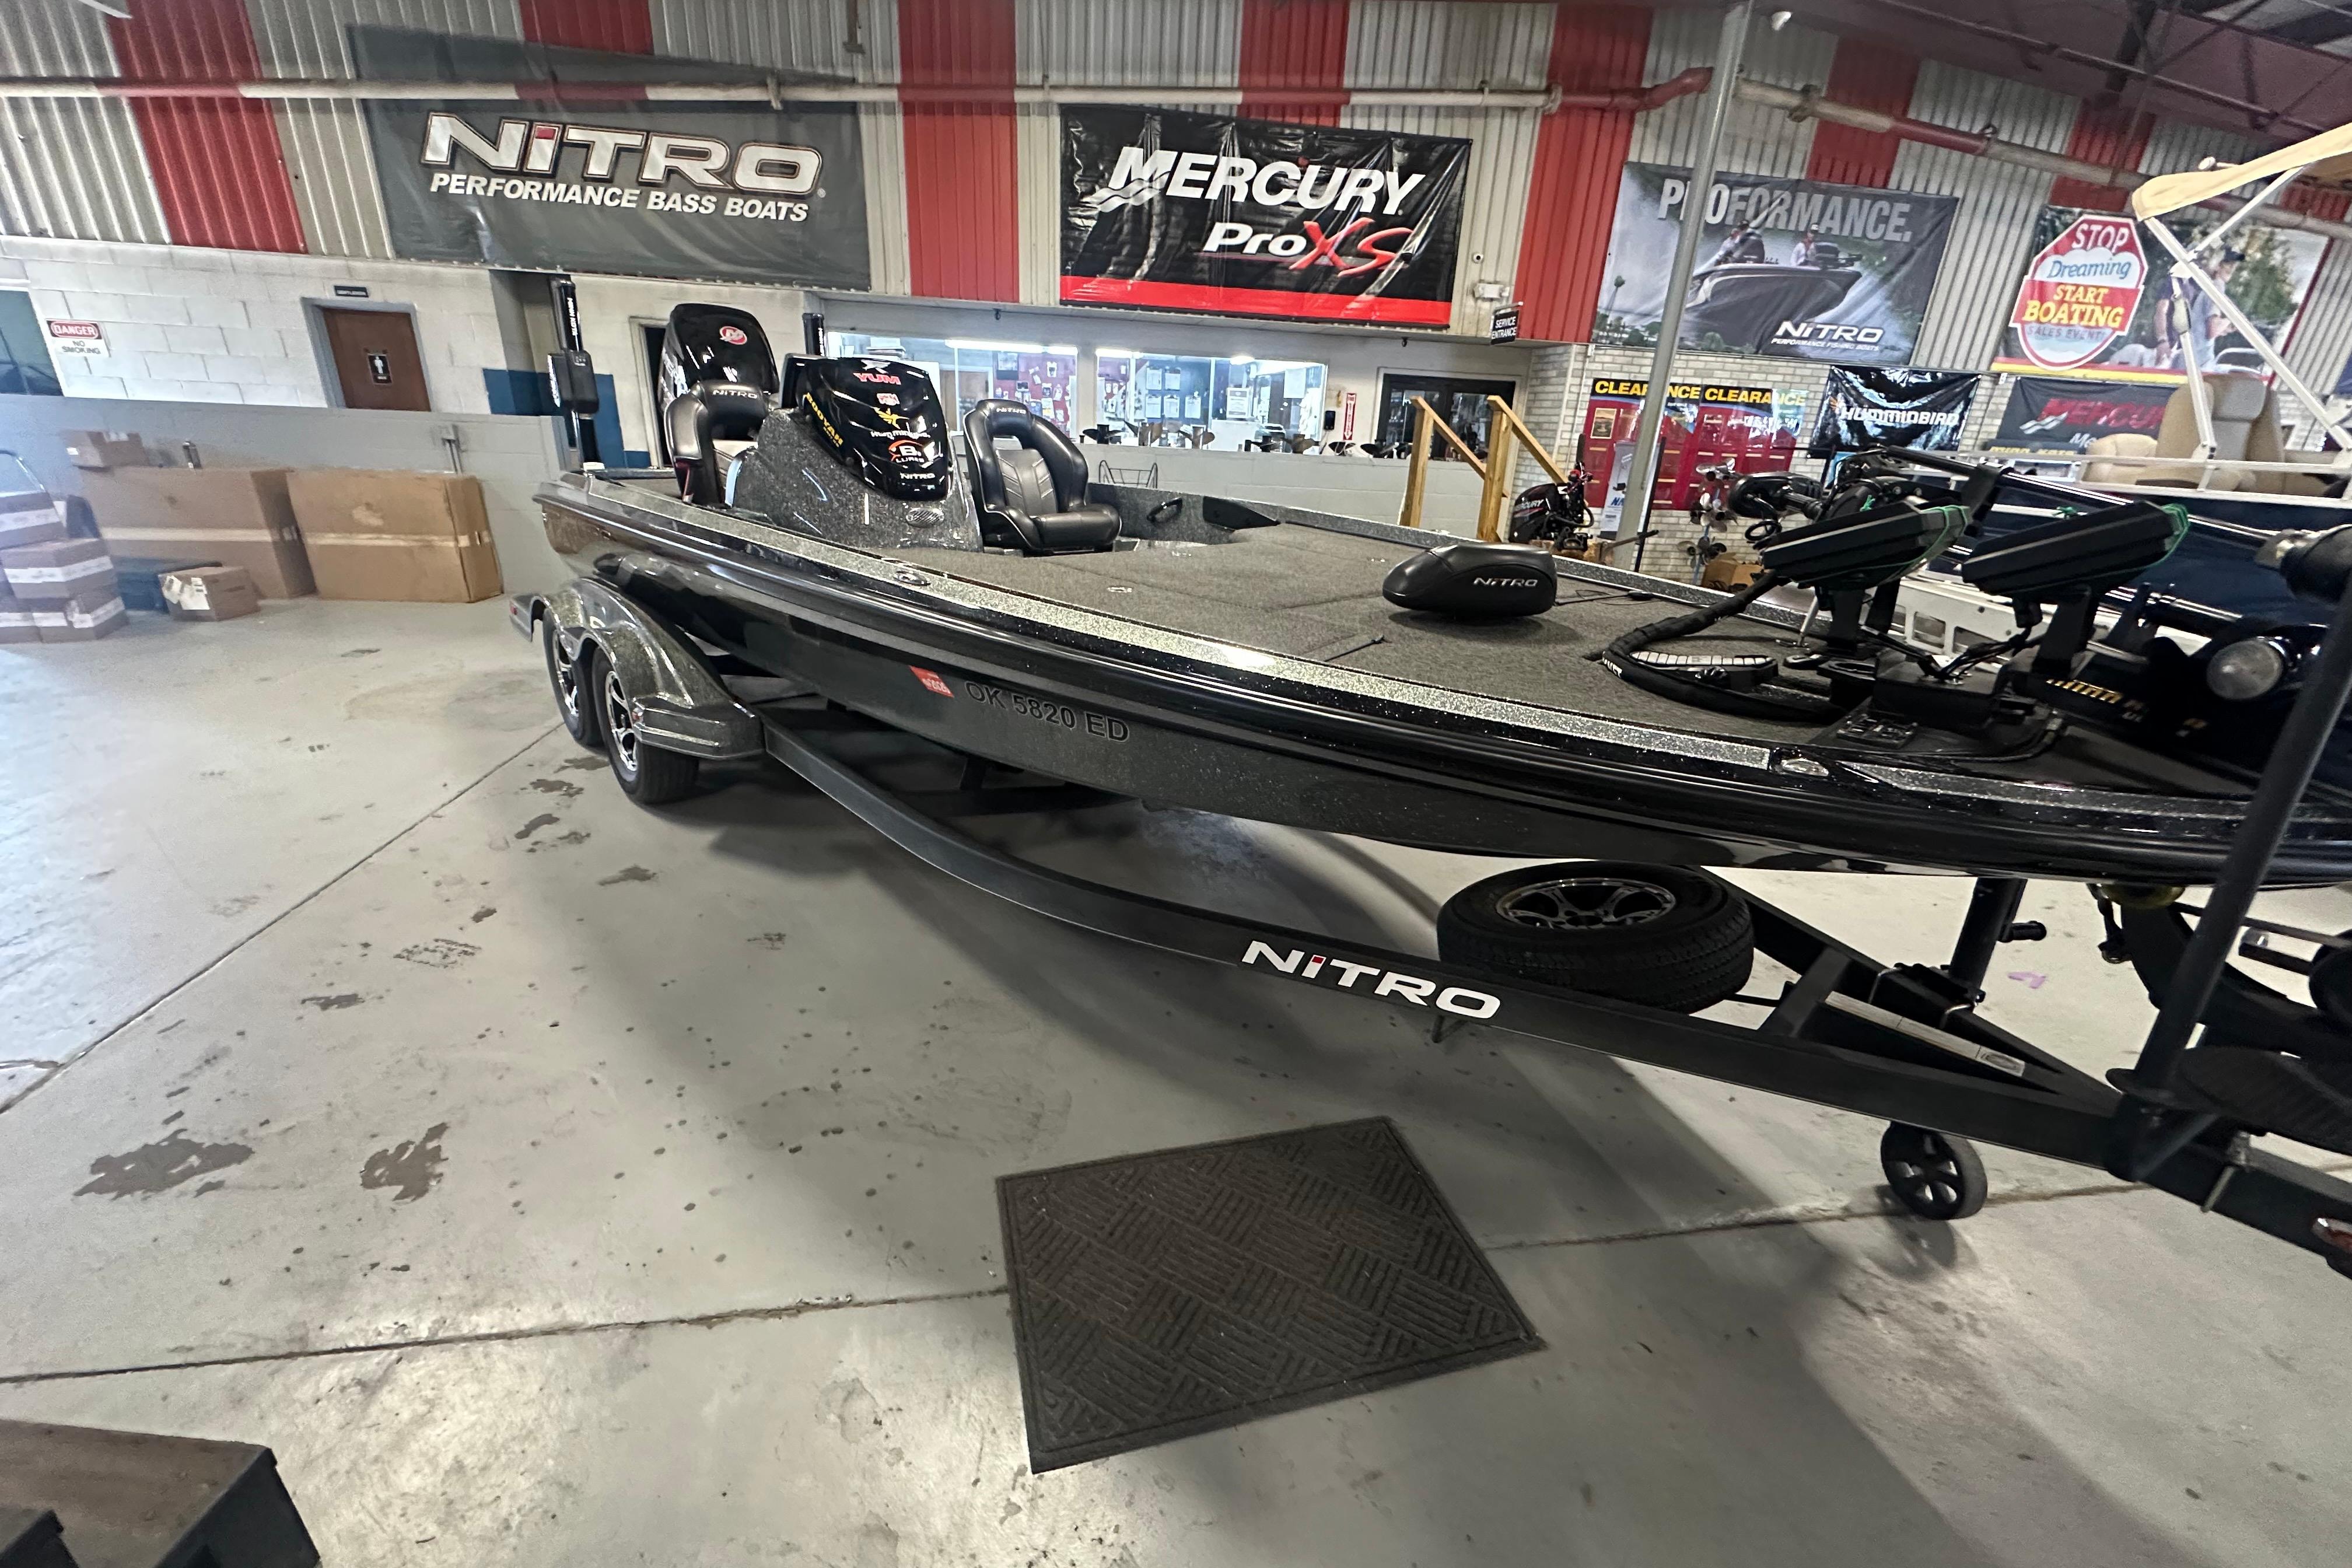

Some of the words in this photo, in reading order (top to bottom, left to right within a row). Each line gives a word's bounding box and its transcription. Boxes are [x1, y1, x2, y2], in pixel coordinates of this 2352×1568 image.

[1094, 146, 1425, 215] MERCURY
[430, 173, 638, 209] PERFORMANCE
[647, 192, 717, 215] BASS
[724, 198, 808, 222] BOATS
[1657, 178, 1912, 242] POFORMANCE.
[2072, 223, 2130, 253] STOP
[2047, 257, 2132, 279] Dreaming
[2053, 284, 2109, 303] START
[1495, 316, 1517, 328] SERVICE
[2022, 300, 2124, 328] BOATING
[53, 325, 96, 335] DANGER
[1492, 327, 1517, 339] ENTRANCE
[2027, 326, 2062, 337] SALES
[62, 345, 101, 354] SMOKING
[1771, 338, 1826, 347] PERFORMANCE
[1595, 381, 1702, 399] CLEANCE
[2036, 398, 2166, 430] MERCUR
[964, 681, 1007, 709] OK
[1012, 693, 1077, 730] 5820
[1084, 710, 1130, 743] ED
